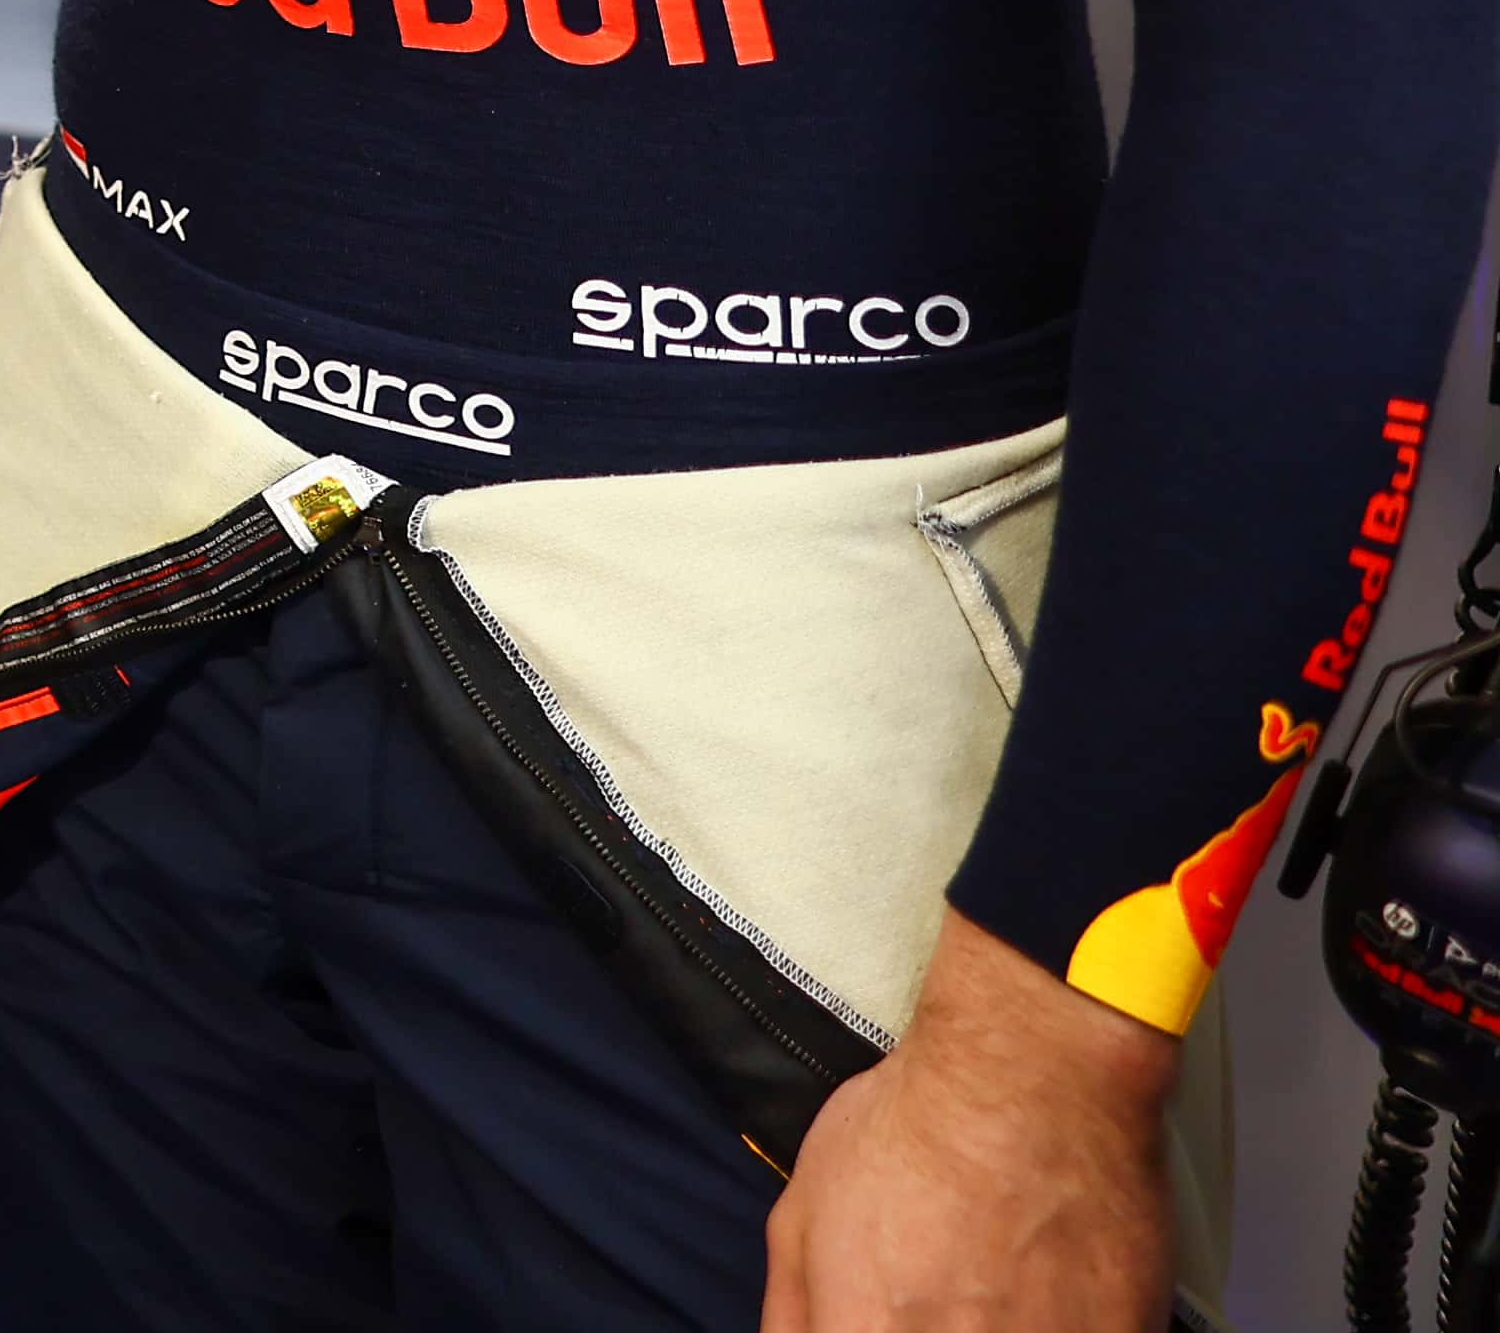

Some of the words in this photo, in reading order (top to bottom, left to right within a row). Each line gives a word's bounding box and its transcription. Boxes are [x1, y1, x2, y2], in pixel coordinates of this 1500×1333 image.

[92, 165, 190, 241] MAX
[572, 278, 970, 358] sparco
[221, 328, 516, 441] sparco
[1301, 546, 1394, 690] Red
[1360, 397, 1428, 546] Bull
